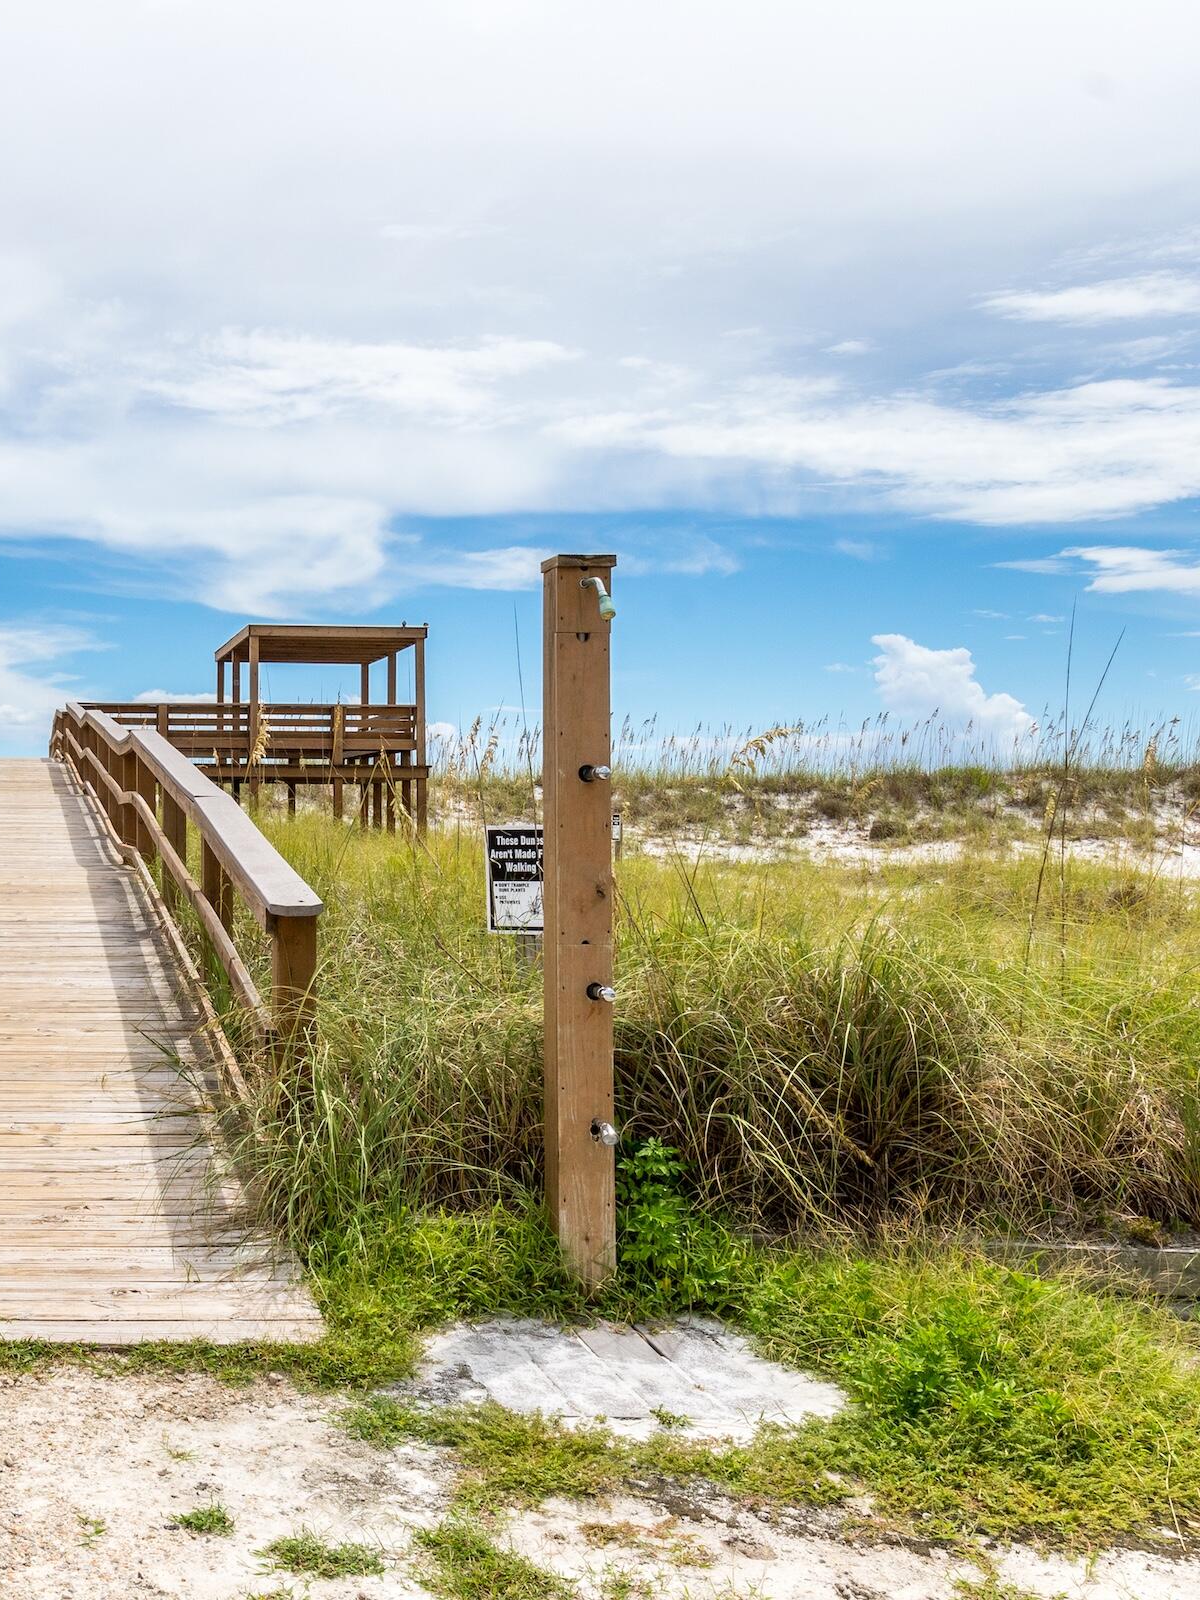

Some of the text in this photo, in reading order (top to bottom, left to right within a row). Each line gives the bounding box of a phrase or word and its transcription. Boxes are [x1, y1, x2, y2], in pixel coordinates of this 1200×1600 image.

[496, 835, 519, 846] These
[490, 848, 513, 859] Aren't
[514, 848, 537, 859] Made
[505, 862, 537, 874] Walking
